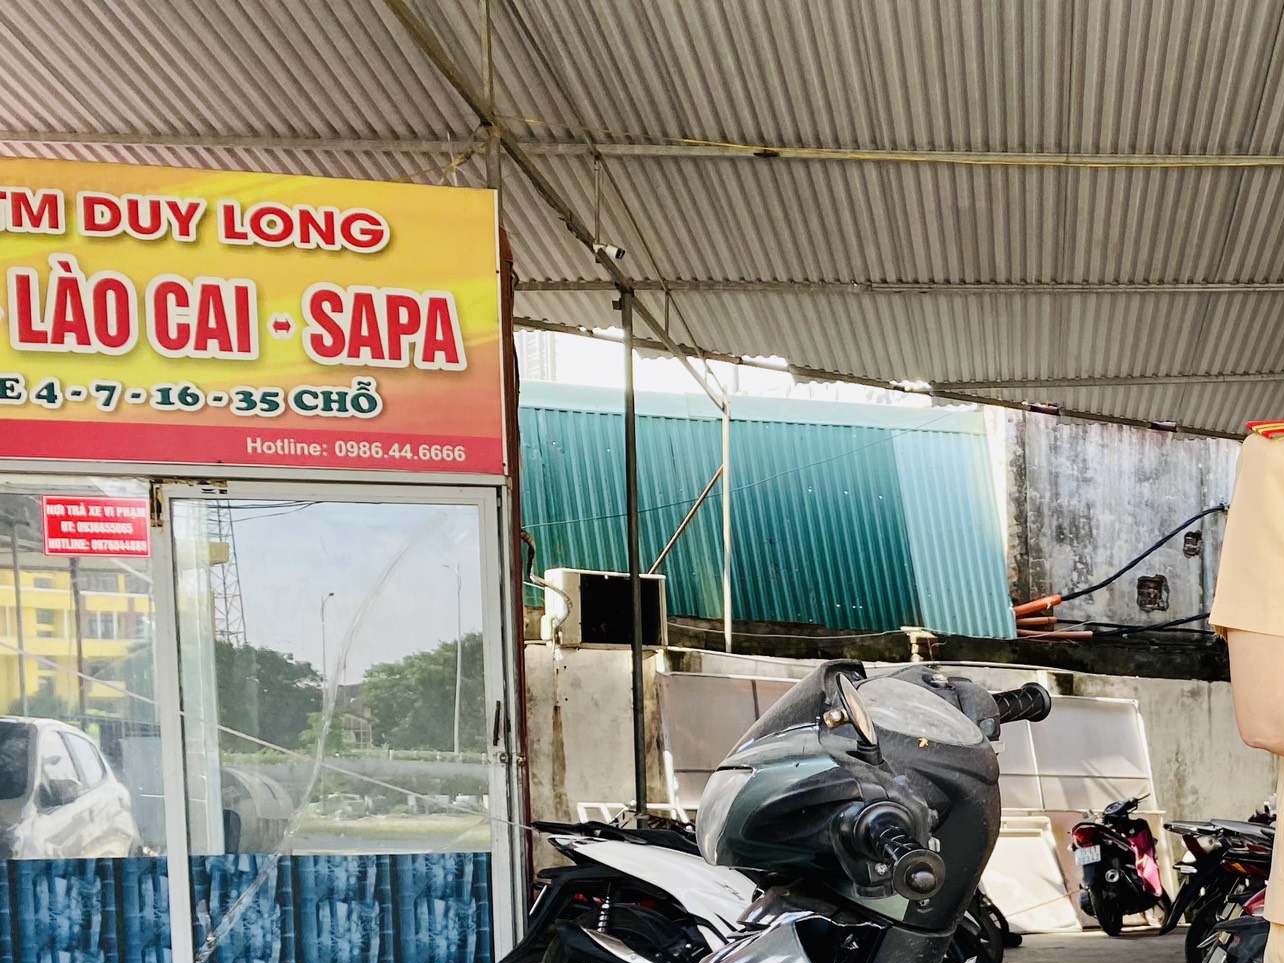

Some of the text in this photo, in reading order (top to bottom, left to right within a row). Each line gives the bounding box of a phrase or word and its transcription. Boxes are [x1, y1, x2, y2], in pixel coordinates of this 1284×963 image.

[0, 191, 385, 248] M DUY LONG
[15, 260, 460, 364] LÀO CAI SAPA
[35, 381, 58, 404] 4
[95, 386, 117, 407] 7
[155, 386, 200, 408] 16
[235, 389, 280, 413] 35
[293, 379, 379, 414] CHỖ
[246, 436, 466, 462] Hotline: 0986.44.6666
[88, 505, 102, 517] XE
